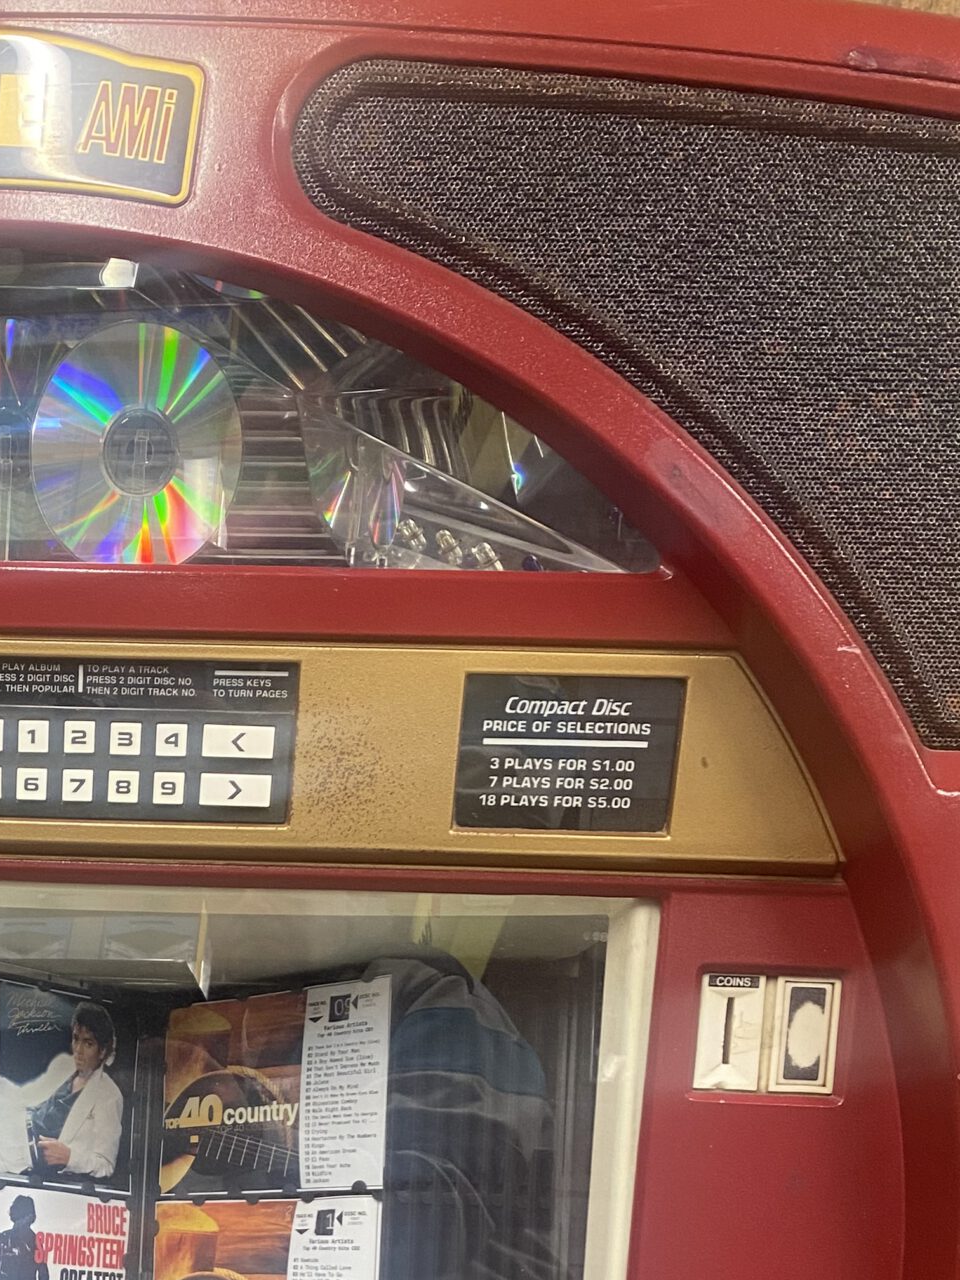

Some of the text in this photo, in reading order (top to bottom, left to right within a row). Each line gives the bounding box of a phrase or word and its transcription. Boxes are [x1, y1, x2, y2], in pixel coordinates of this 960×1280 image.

[2, 663, 25, 671] PLAY
[28, 664, 60, 672] ALBUM
[87, 665, 99, 673] TO
[102, 665, 125, 673] PLAY
[139, 666, 169, 674] TRACK
[28, 674, 50, 682] DIGIT
[54, 675, 75, 683] DISC
[86, 676, 116, 684] PRESS
[119, 676, 125, 684] 2
[127, 677, 150, 685] DIGIT
[247, 679, 271, 687] KEYS
[32, 685, 75, 693] POPULAR
[86, 687, 110, 695] THEN
[112, 687, 118, 695] 2
[121, 687, 144, 696] DIGIT
[148, 688, 178, 696] TRACK
[213, 689, 288, 698] TO TURN PAGES
[505, 696, 632, 717] Compact Disc
[483, 721, 652, 735] PRICE OF SELECTIONS
[27, 729, 36, 744] 1
[71, 730, 87, 745] 2
[117, 732, 134, 746] 3
[164, 732, 179, 747] 4
[490, 758, 635, 772] 3 PLAYS FOR $1.00
[23, 777, 39, 791] 6
[69, 778, 86, 792] 7
[115, 779, 131, 795] 8
[160, 781, 176, 795] 9
[489, 776, 633, 791] 7 PLAYS FOR $2.00
[479, 795, 631, 809] 18 PLAYS FOR $5.00
[716, 977, 751, 987] COINS
[179, 1094, 223, 1127] 40
[223, 1102, 299, 1126] country
[87, 1203, 127, 1236] BRUCE
[35, 1232, 125, 1270] SPRINGSTEEN
